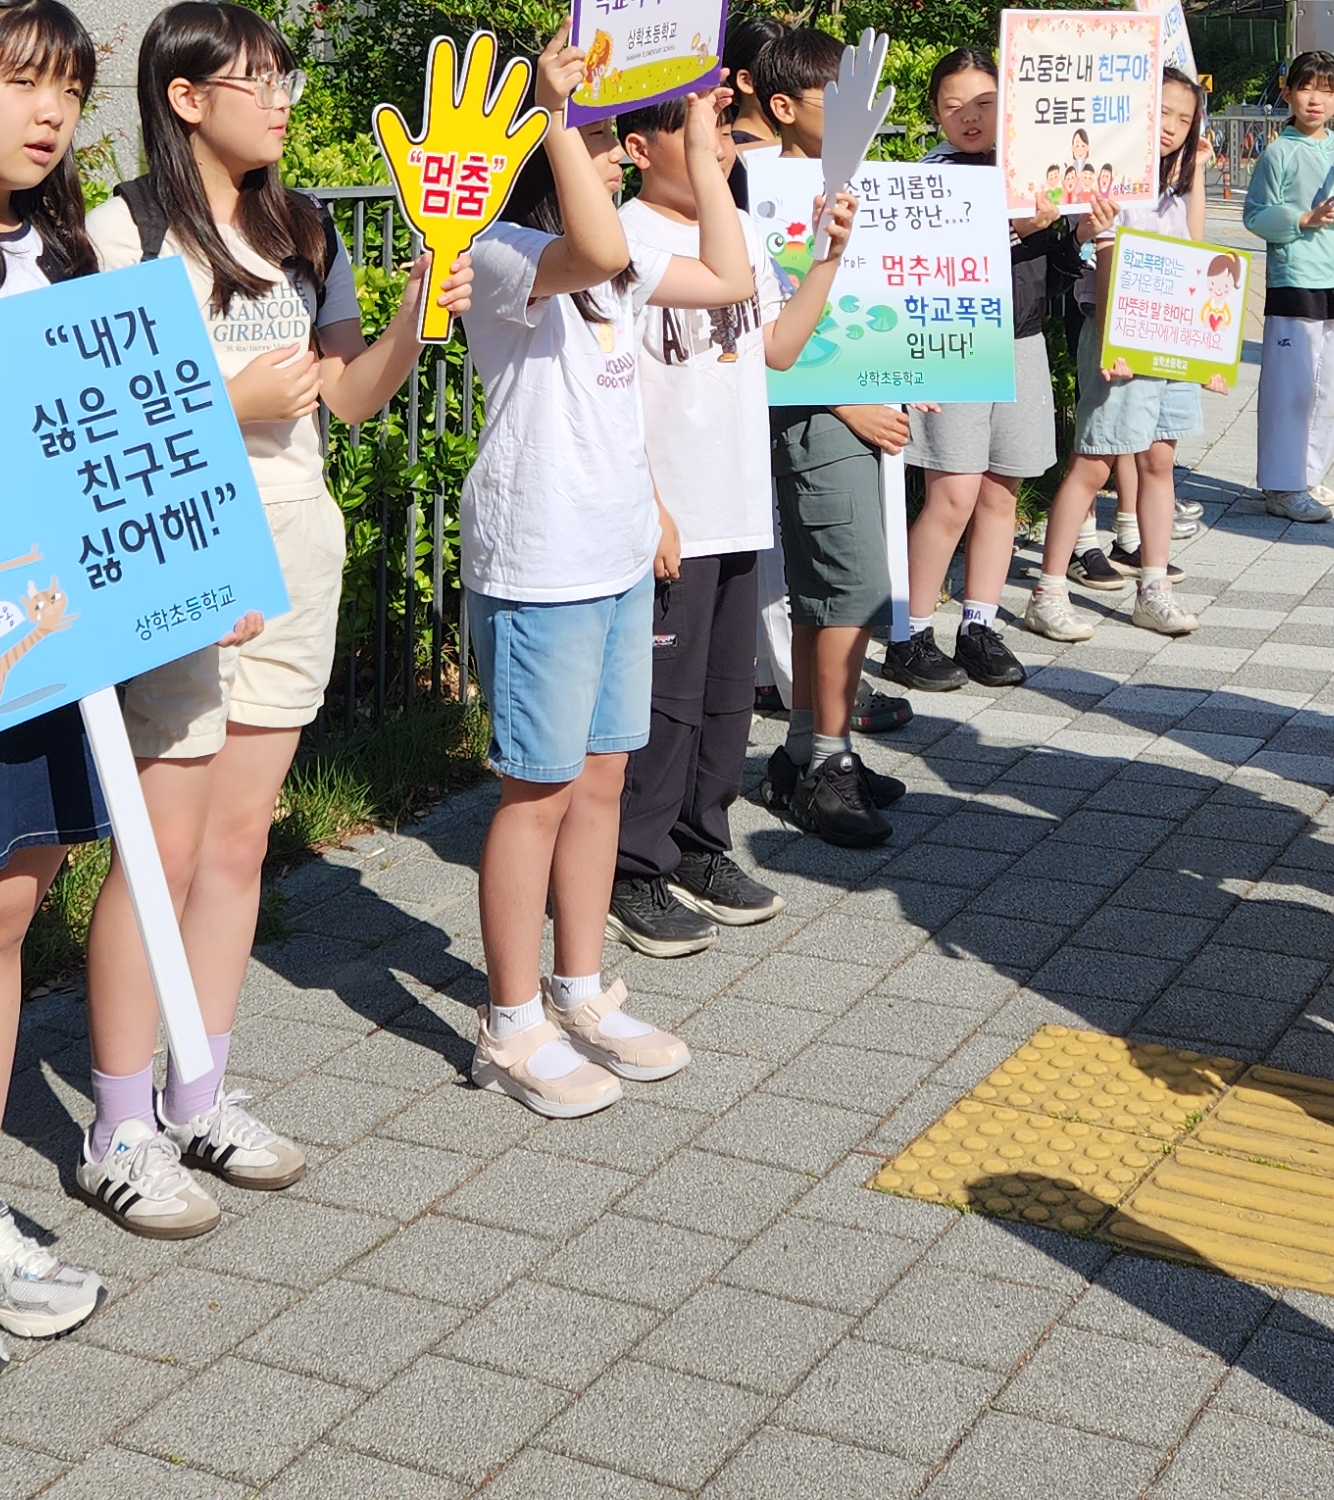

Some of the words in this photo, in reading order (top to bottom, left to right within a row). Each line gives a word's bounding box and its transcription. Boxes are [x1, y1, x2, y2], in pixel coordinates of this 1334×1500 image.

[628, 22, 677, 50] 상학초등학교
[1019, 54, 1073, 83] 소중한
[1076, 54, 1093, 82] 내
[1098, 53, 1148, 82] 친구야
[1034, 97, 1086, 125] 오늘도
[1092, 95, 1131, 124] 힘내!
[823, 178, 880, 202] 소한
[888, 174, 952, 200] 괴롭힘,
[859, 207, 898, 232] 그냥
[881, 255, 989, 287] 멈추세요!
[1120, 270, 1153, 293] 즐거운
[1154, 275, 1175, 296] 학교
[904, 295, 1003, 329] 학교폭력
[1118, 296, 1149, 318] 따뜻한
[1150, 301, 1162, 321] 말
[1163, 303, 1194, 326] 한마디
[1115, 317, 1137, 337] 지금
[1137, 320, 1179, 344] 친구에게
[906, 332, 975, 360] 입니다!
[857, 371, 925, 387] 상학초등학교
[32, 385, 119, 460] 싫은
[129, 359, 213, 428] 일은
[77, 429, 209, 514] 친구도
[135, 584, 237, 642] 상학초등학교
